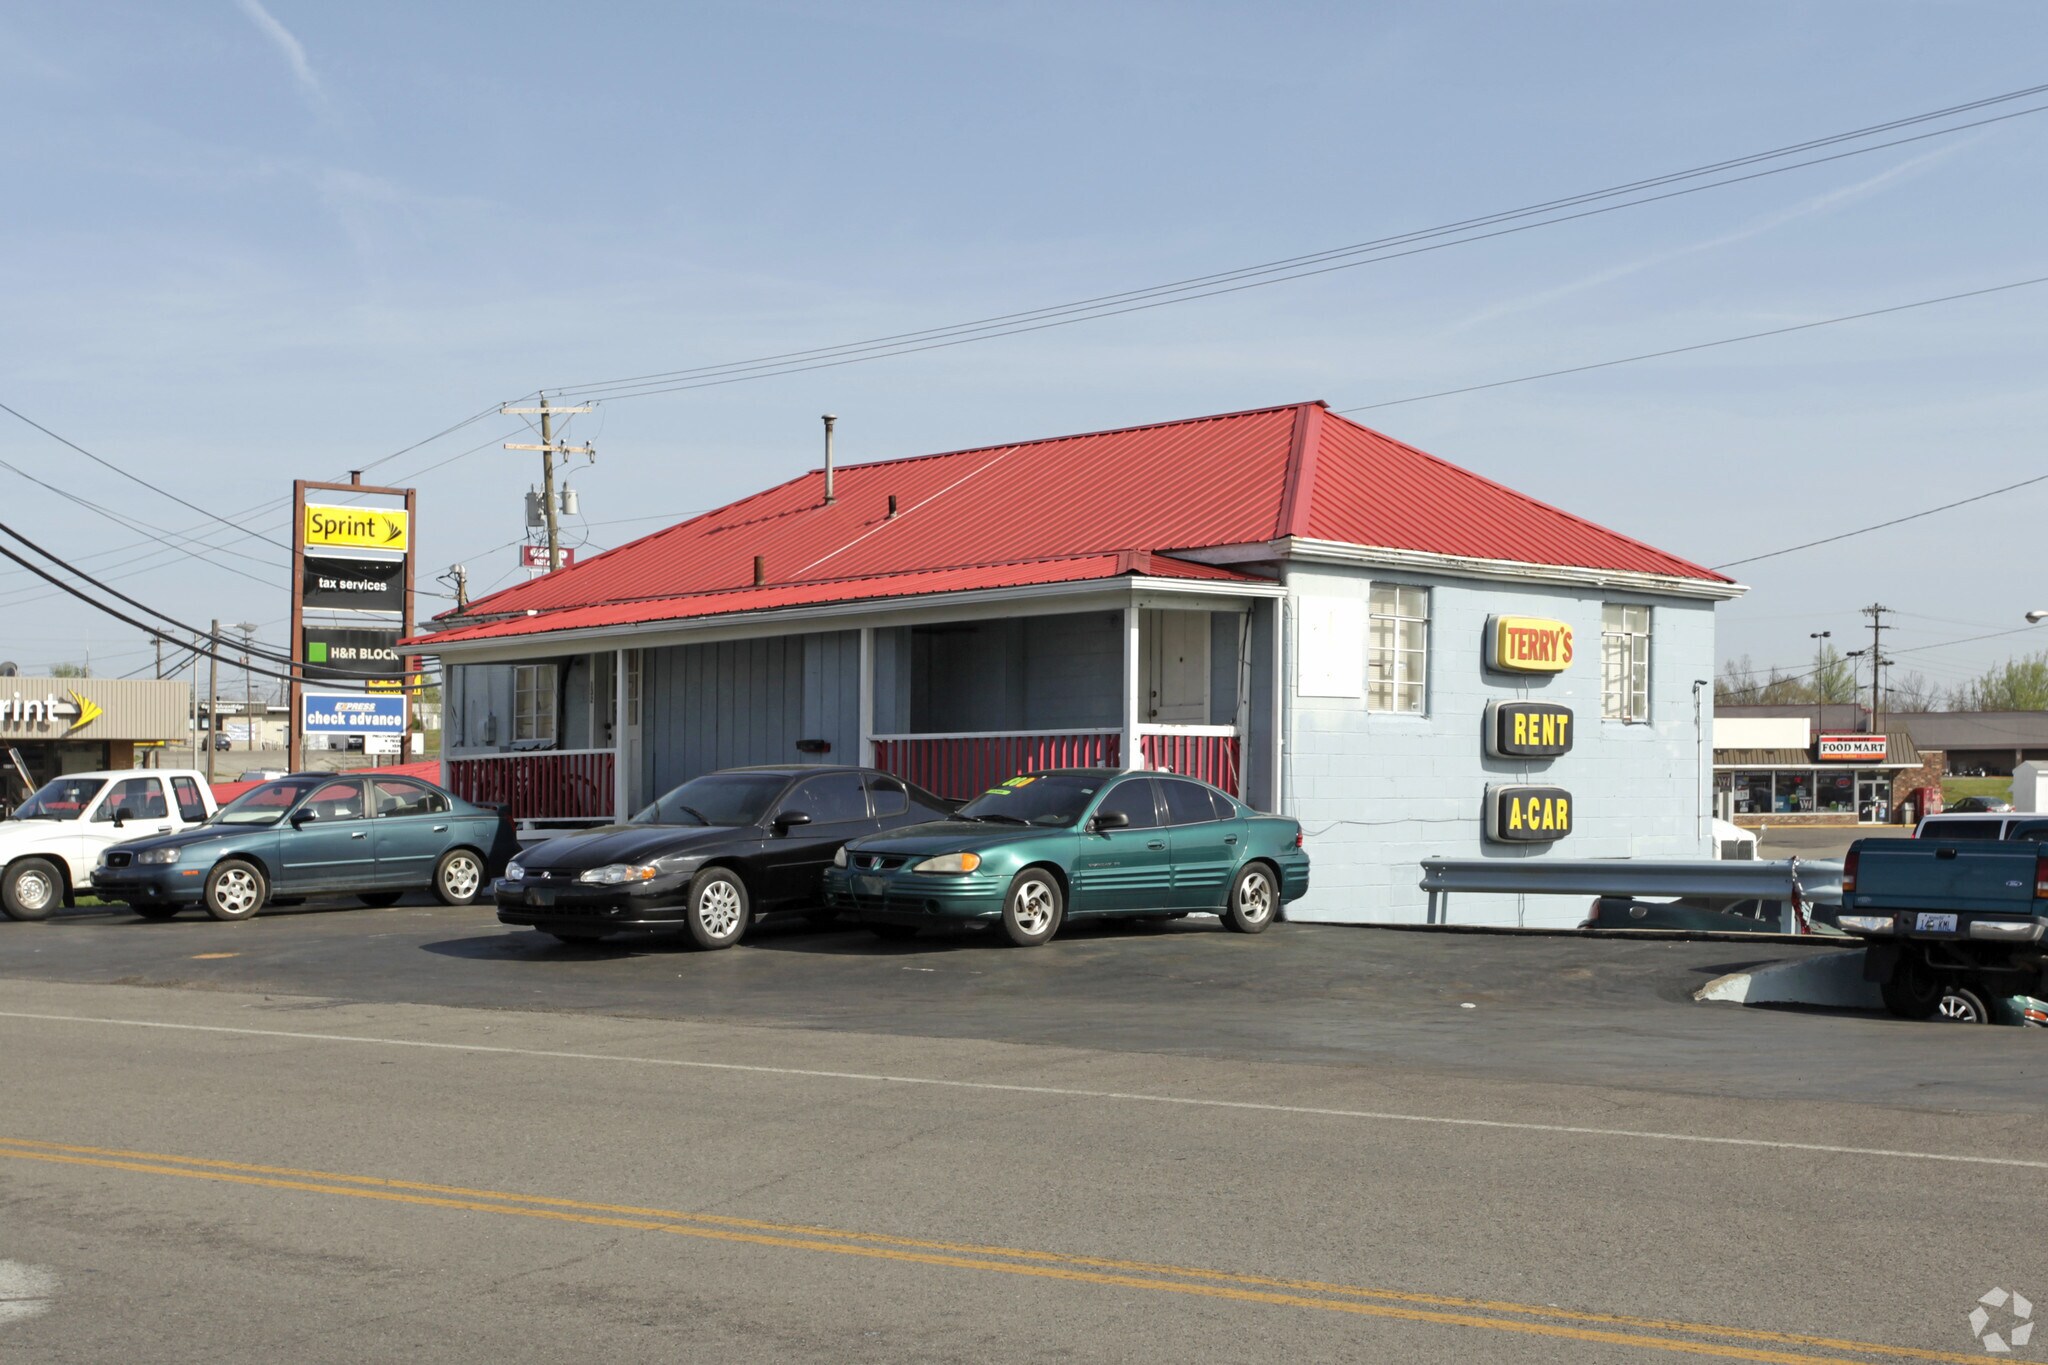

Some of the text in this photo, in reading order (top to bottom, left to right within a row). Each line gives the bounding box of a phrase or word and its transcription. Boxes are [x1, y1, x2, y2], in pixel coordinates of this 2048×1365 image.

[312, 513, 375, 540] Sprint
[319, 577, 387, 591] tax services
[1507, 626, 1573, 663] TERRY'S
[331, 647, 357, 659] H&R
[335, 702, 376, 711] EXPRESS
[307, 710, 402, 726] check advance
[1514, 712, 1568, 746] RENT
[1822, 743, 1885, 752] FOOD MART
[1509, 796, 1568, 831] A-CAR
